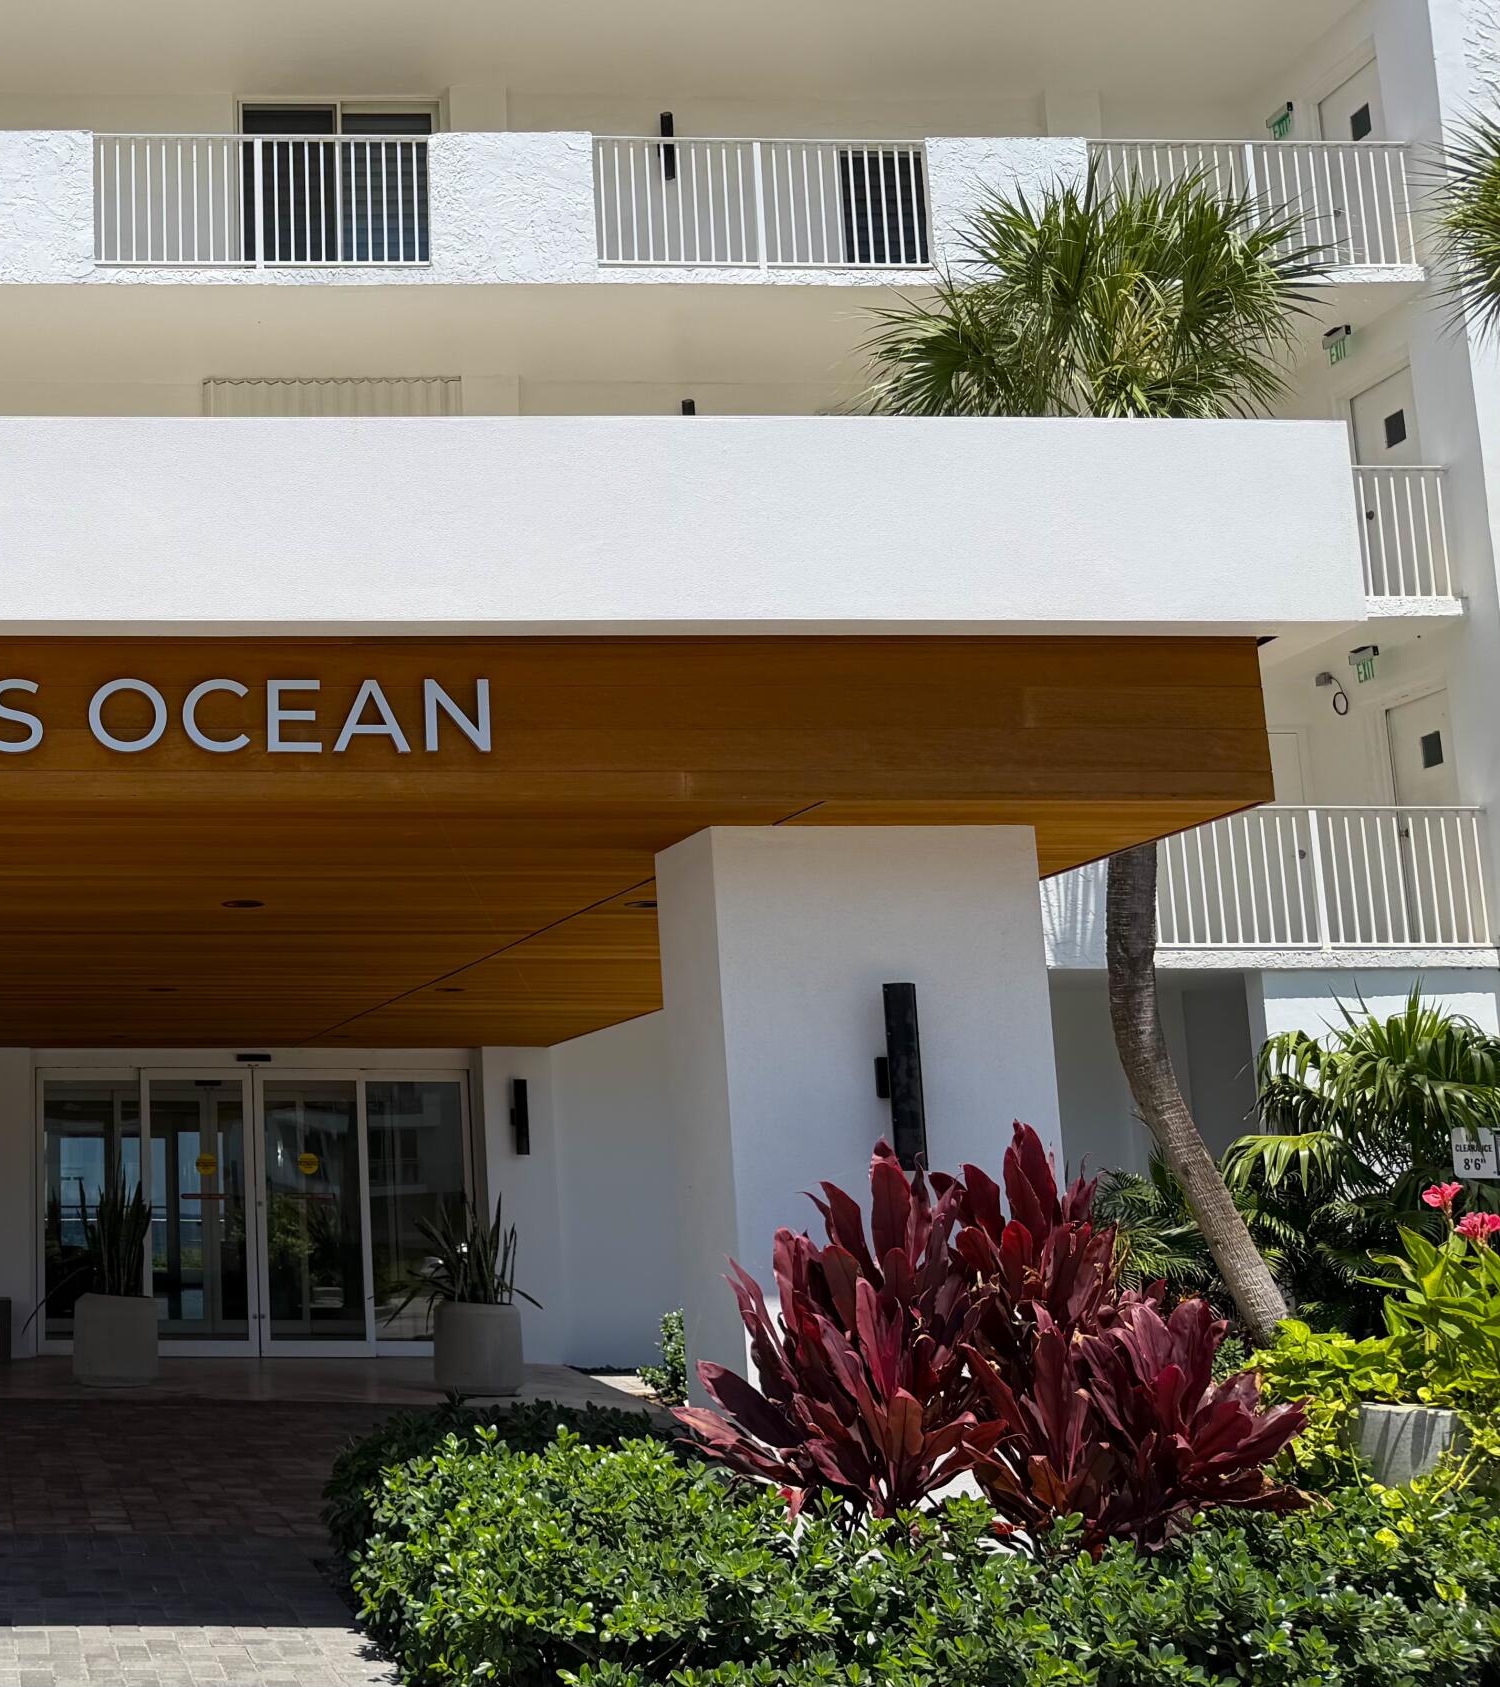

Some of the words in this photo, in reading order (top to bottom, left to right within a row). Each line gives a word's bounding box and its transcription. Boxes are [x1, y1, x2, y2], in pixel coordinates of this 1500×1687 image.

[1273, 116, 1291, 140] EXIT
[1330, 339, 1347, 366] EXIT
[1356, 659, 1375, 683] EXIT
[87, 678, 493, 754] OCEAN
[1455, 1144, 1493, 1152] CLEARCE
